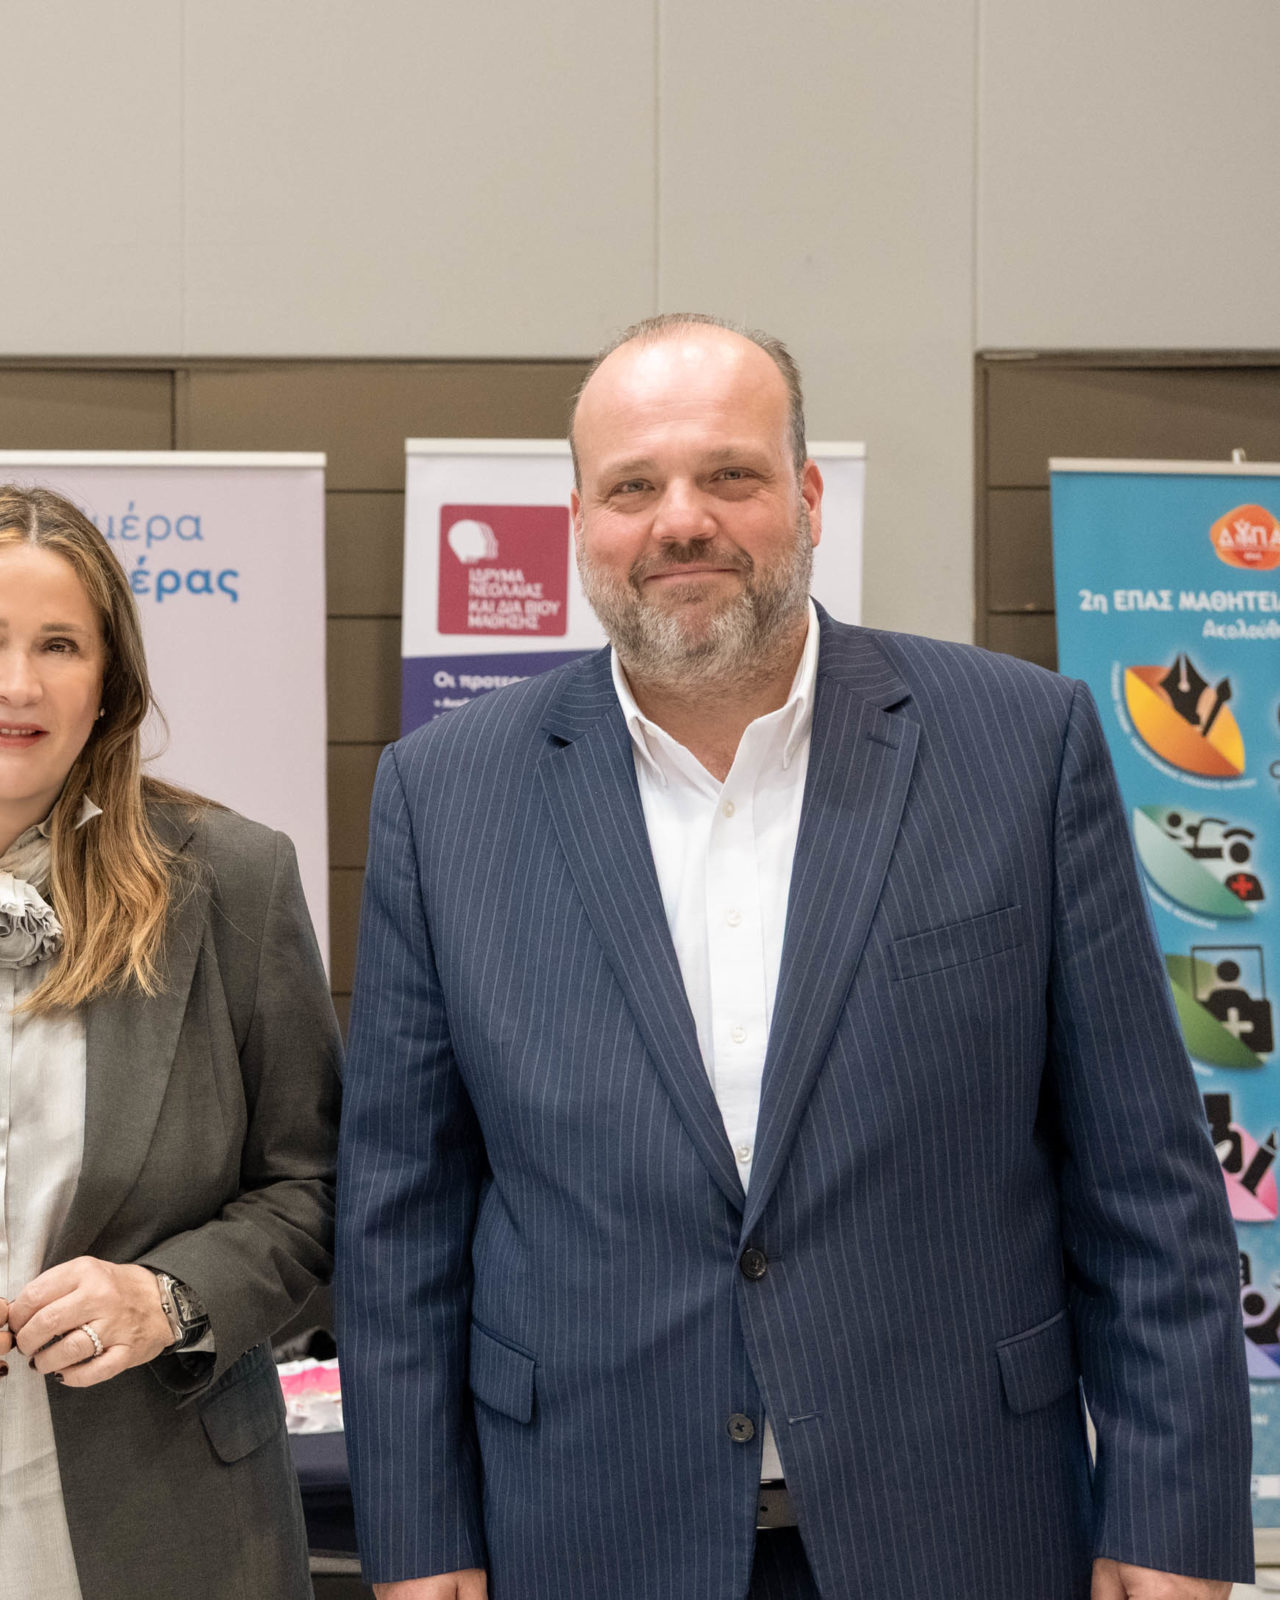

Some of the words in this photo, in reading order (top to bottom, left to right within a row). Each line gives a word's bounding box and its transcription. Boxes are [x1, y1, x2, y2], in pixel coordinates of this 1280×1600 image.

[91, 501, 204, 549] μέρα
[131, 555, 239, 603] έρας
[468, 599, 495, 614] ΚΑΙ
[1078, 588, 1108, 614] 2η
[1113, 589, 1174, 612] ΕΠΑΣ
[1179, 590, 1280, 613] ΜΑΘΗΤΕΙ
[433, 671, 455, 688] Οι
